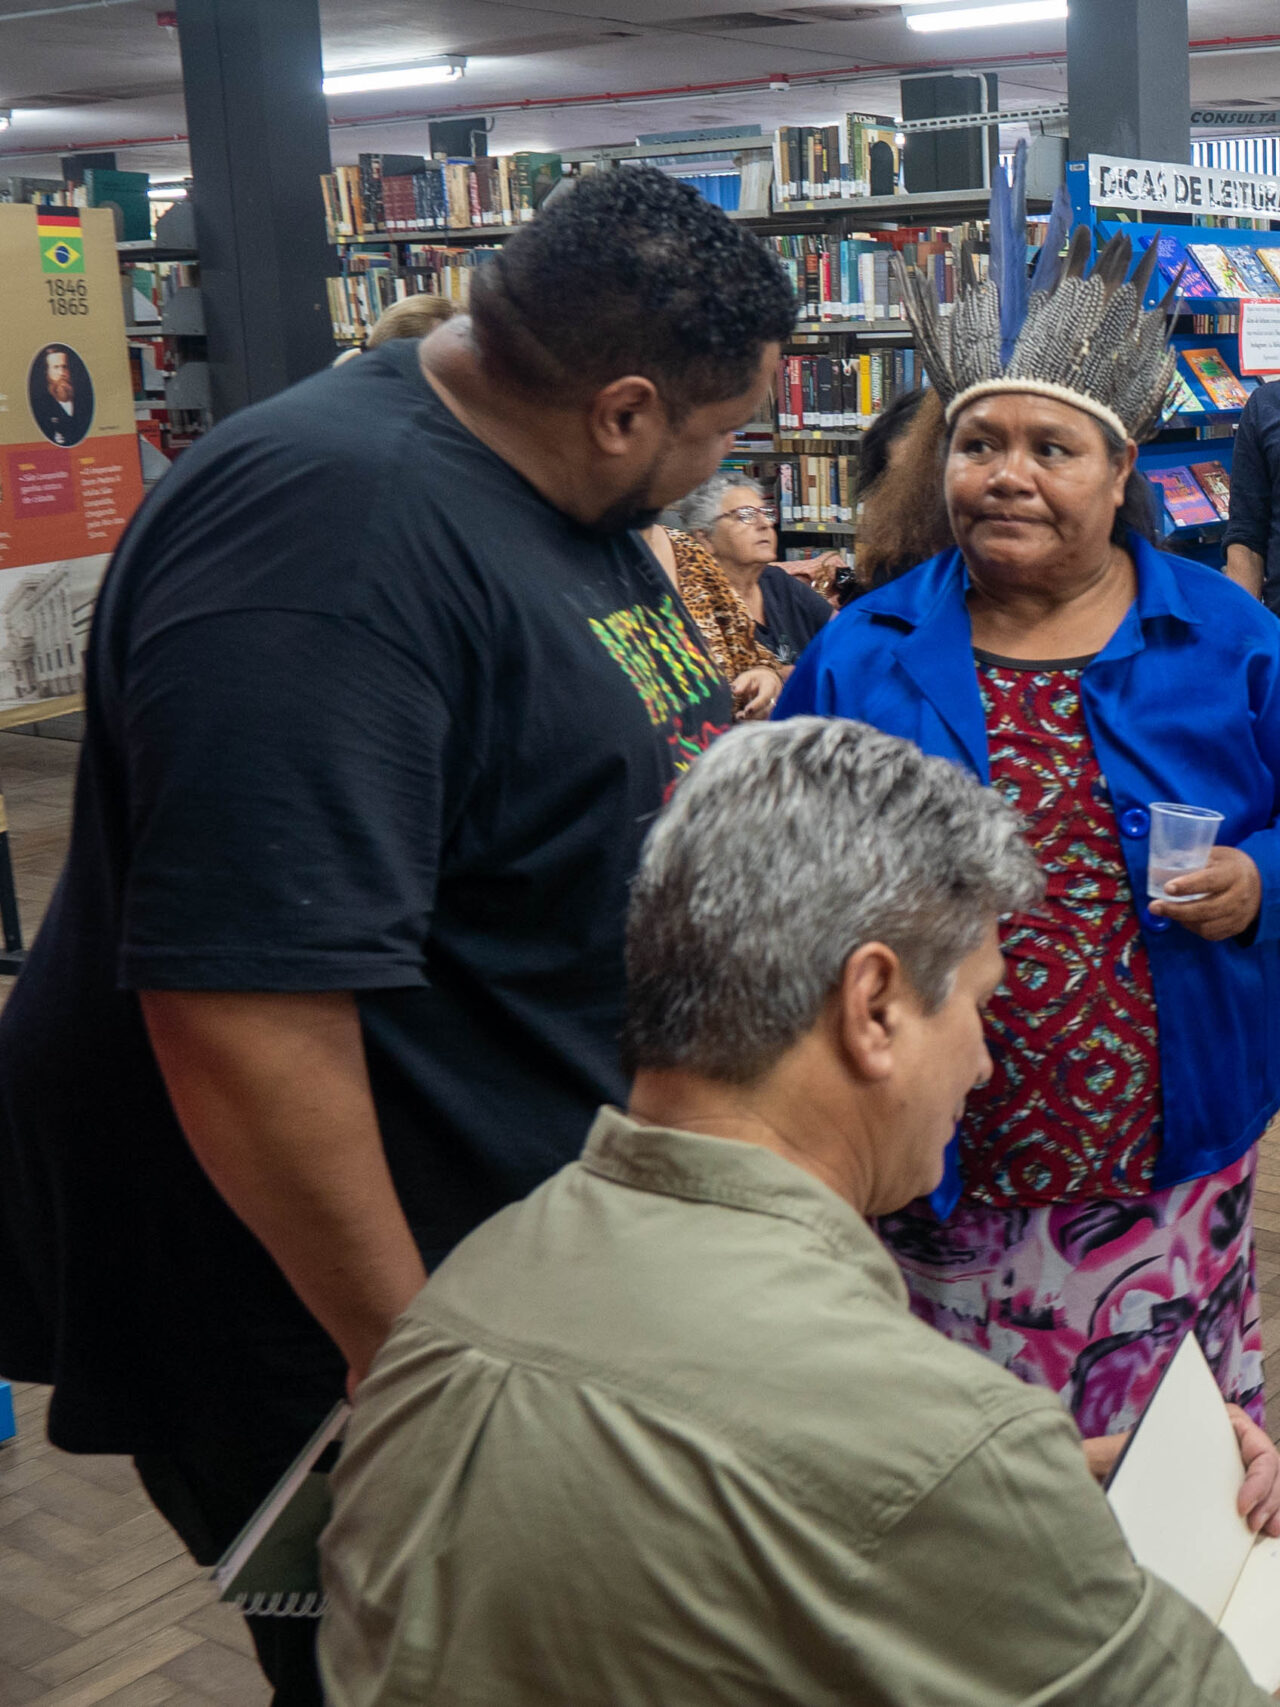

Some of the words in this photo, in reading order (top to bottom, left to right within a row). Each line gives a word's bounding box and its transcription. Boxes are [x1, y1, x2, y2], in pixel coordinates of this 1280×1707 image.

[1190, 111, 1276, 124] CONSULTA
[1100, 166, 1167, 201] DICAS
[1174, 174, 1203, 206] DE
[46, 279, 88, 296] 1846
[48, 298, 88, 315] 1865
